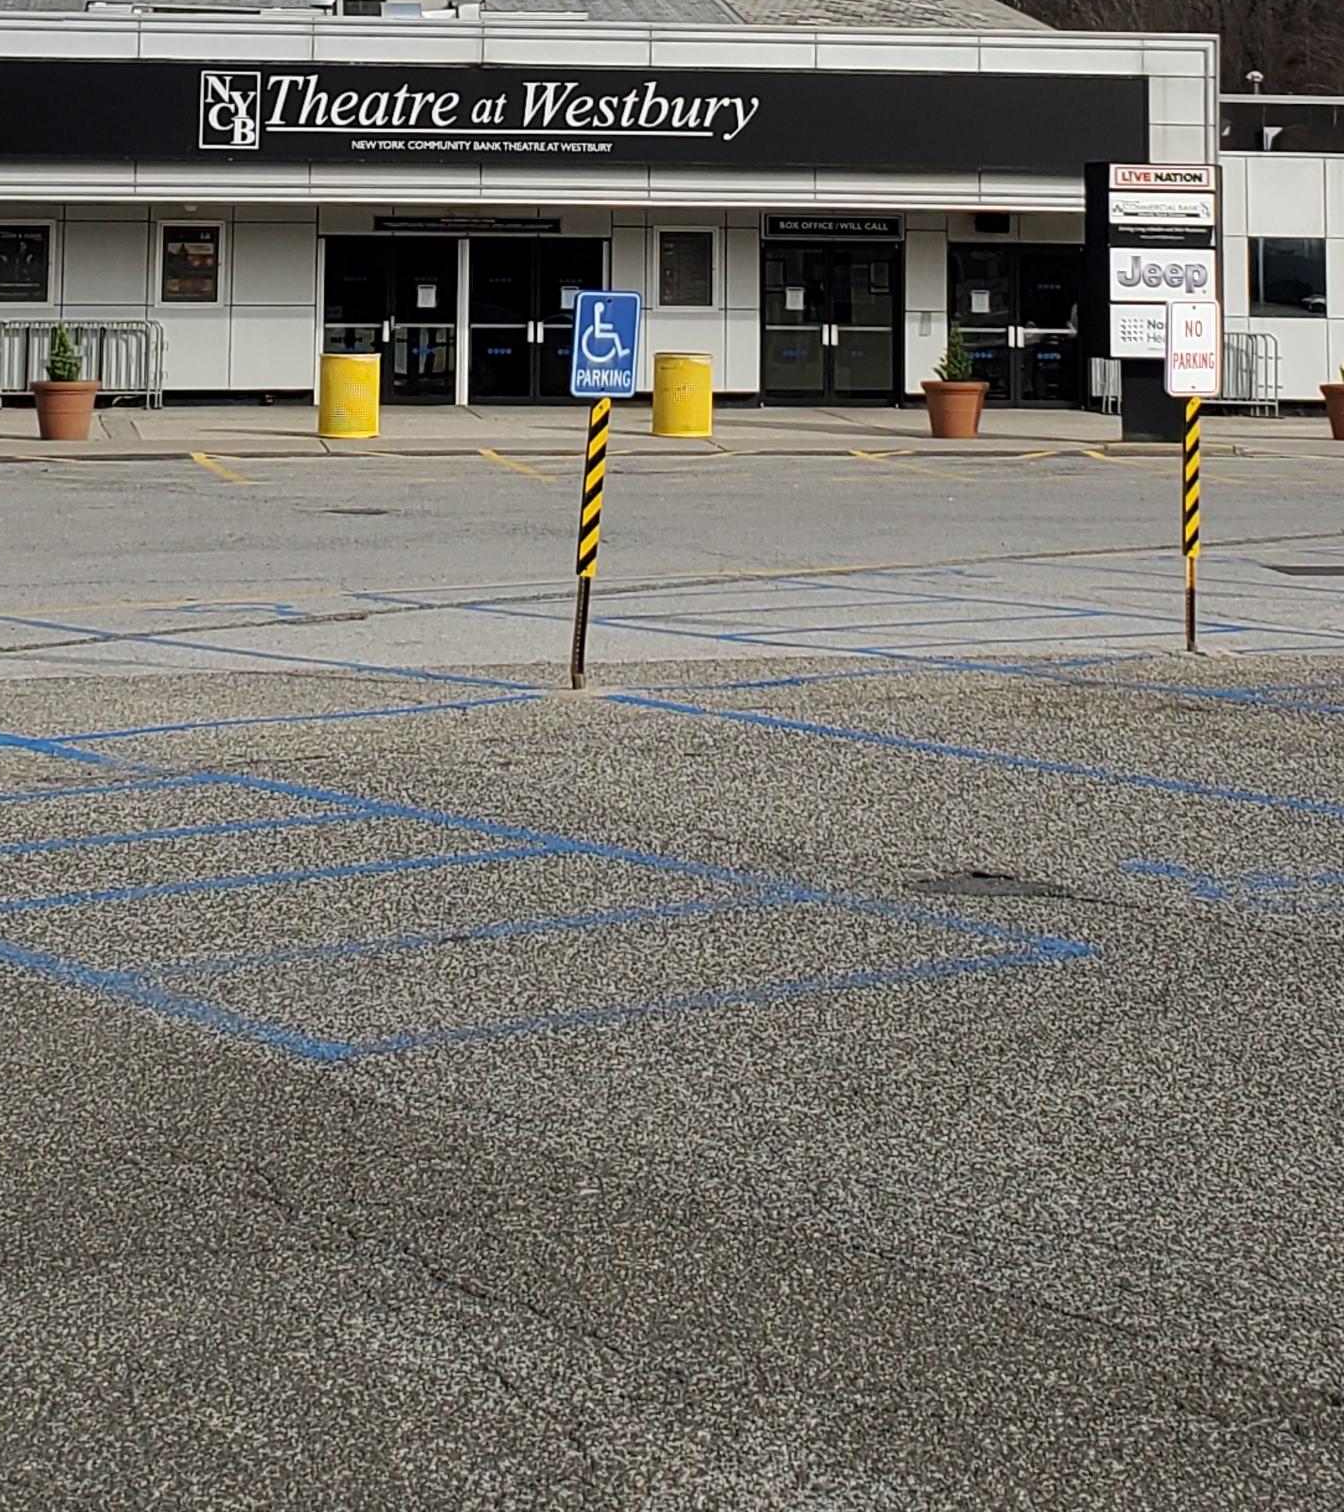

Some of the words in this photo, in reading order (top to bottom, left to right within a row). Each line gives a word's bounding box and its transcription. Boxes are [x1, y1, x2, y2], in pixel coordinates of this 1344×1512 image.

[264, 74, 460, 127] Theatre
[471, 92, 507, 124] at
[522, 81, 759, 141] Westbury
[351, 140, 378, 150] NEW
[378, 140, 405, 150] YORK
[407, 141, 472, 151] COMMUNITY
[473, 141, 502, 152] BANK
[503, 142, 546, 152] THEATRE
[546, 143, 560, 152] AT
[560, 143, 613, 152] WESTBURY
[1121, 171, 1151, 182] LIVE
[1154, 172, 1203, 183] NATION
[779, 221, 799, 229] BOX
[801, 221, 833, 230] OFFICE
[840, 222, 862, 230] WILL
[864, 222, 888, 231] CALL
[1116, 255, 1208, 294] Jeep
[1184, 320, 1203, 338] NO
[1172, 352, 1215, 369] PARKING
[576, 369, 631, 387] PARKING
